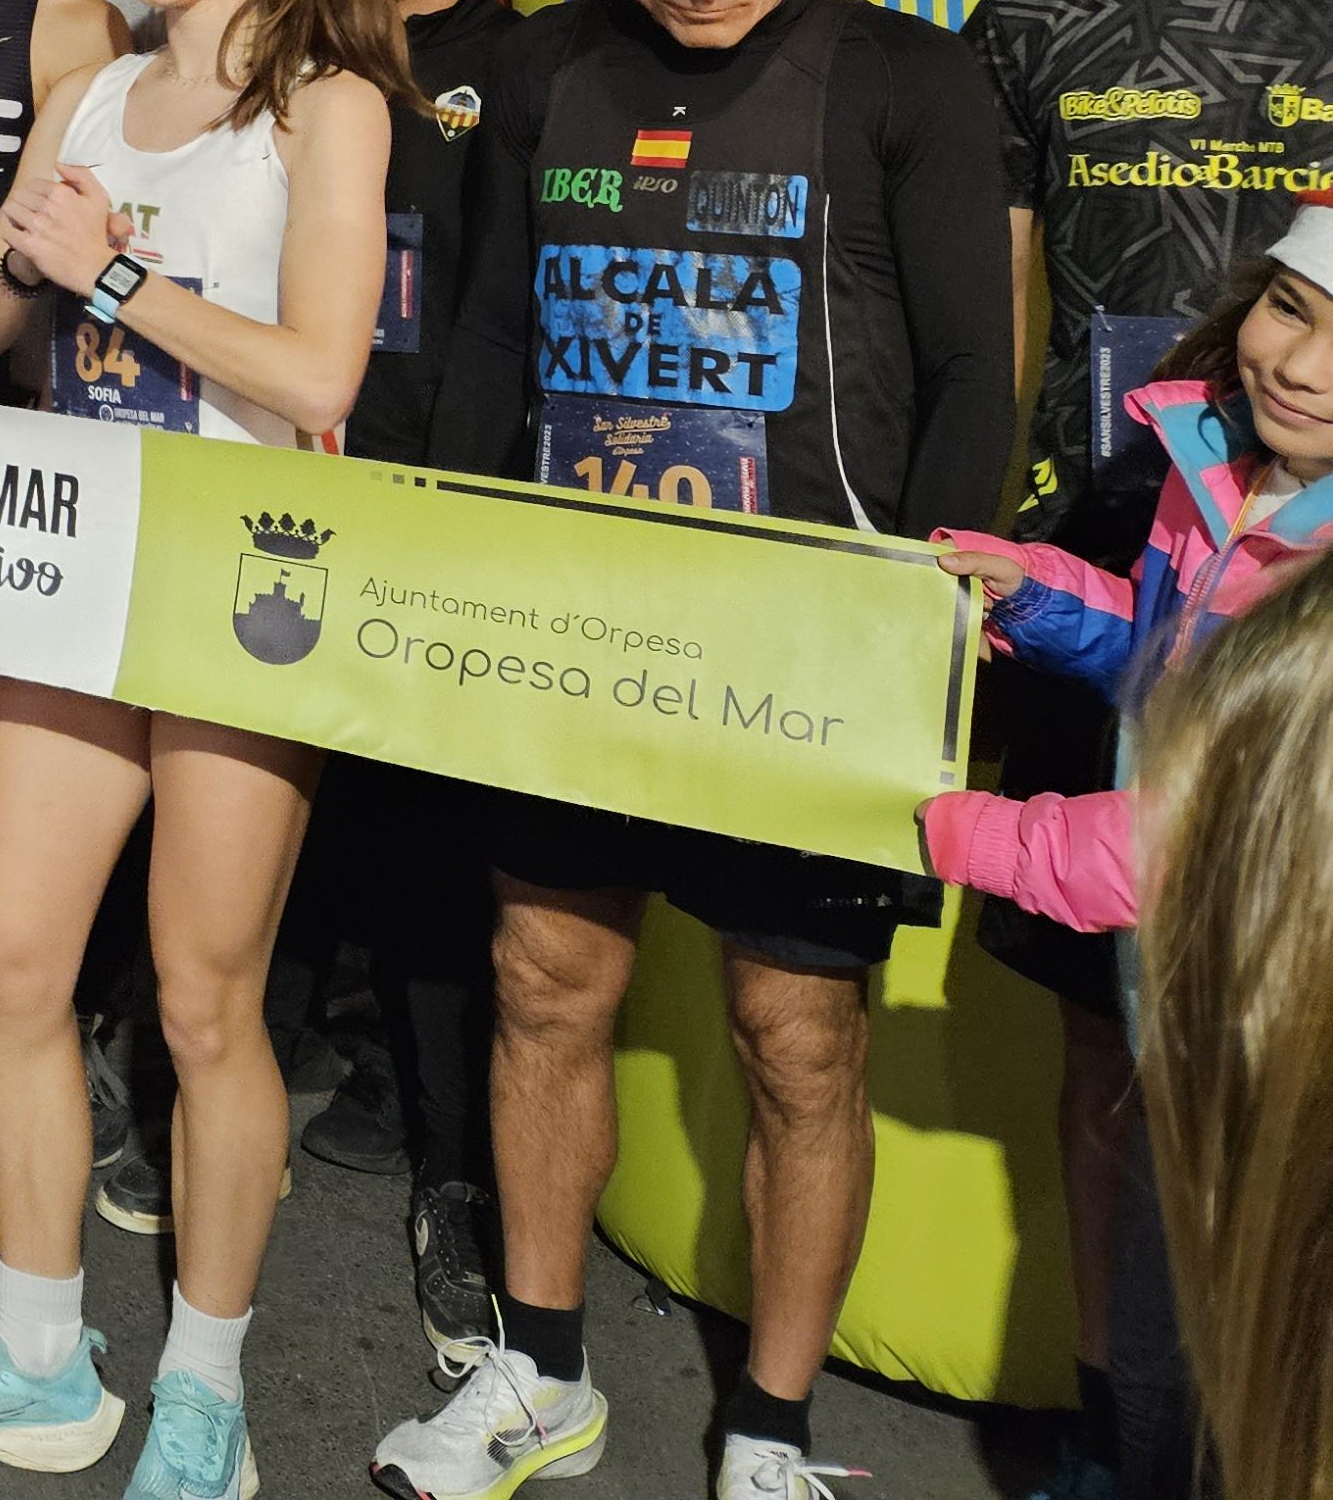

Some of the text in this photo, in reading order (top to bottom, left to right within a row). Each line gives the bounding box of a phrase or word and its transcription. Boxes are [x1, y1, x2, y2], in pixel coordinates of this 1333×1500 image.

[544, 256, 785, 316] ALCALA
[624, 312, 662, 336] DE
[76, 322, 141, 388] 84
[544, 336, 782, 398] XIVERT
[87, 385, 121, 404] SOFIA
[360, 576, 540, 631] Ajuntament
[357, 617, 846, 748] Oropesa del Mar
